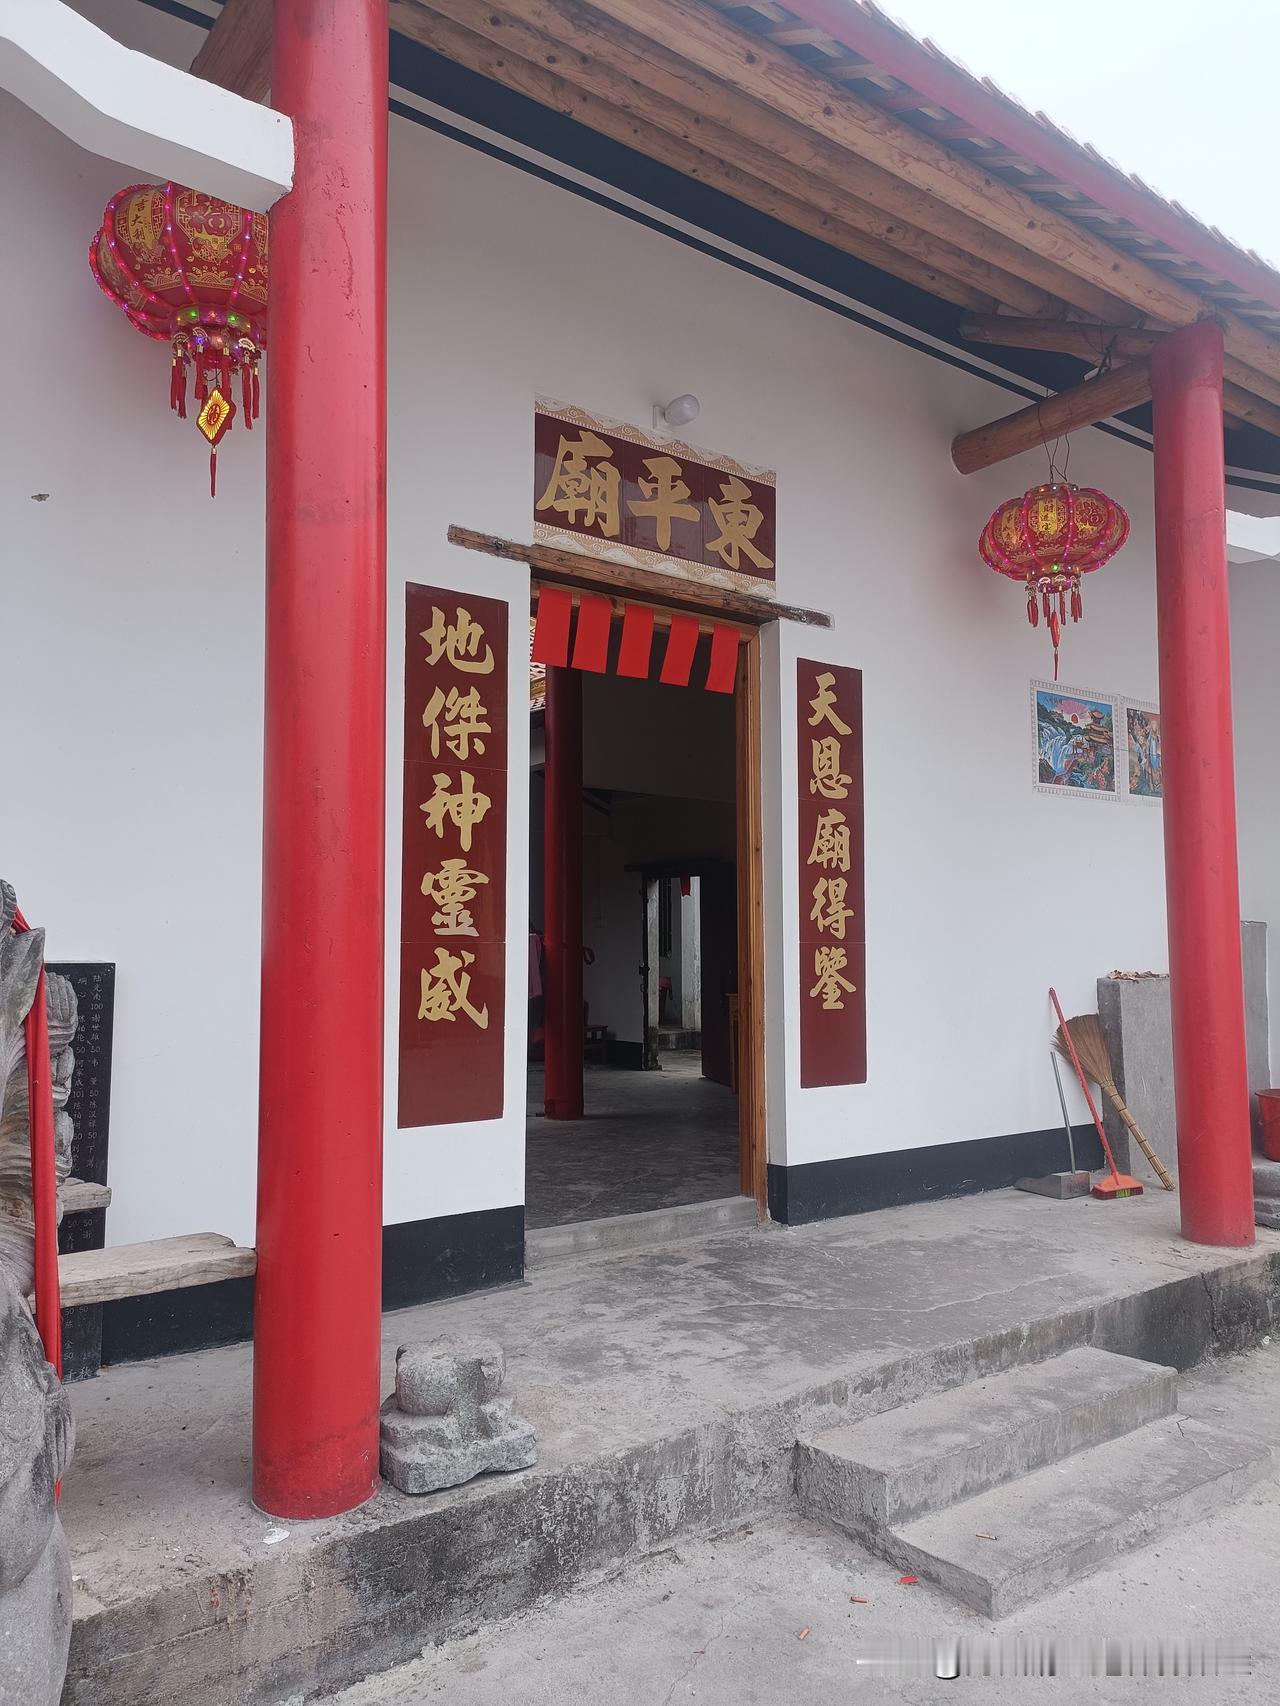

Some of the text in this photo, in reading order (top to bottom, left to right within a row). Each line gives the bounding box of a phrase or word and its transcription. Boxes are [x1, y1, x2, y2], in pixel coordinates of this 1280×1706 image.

[417, 607, 495, 1029] 地傑神靈威
